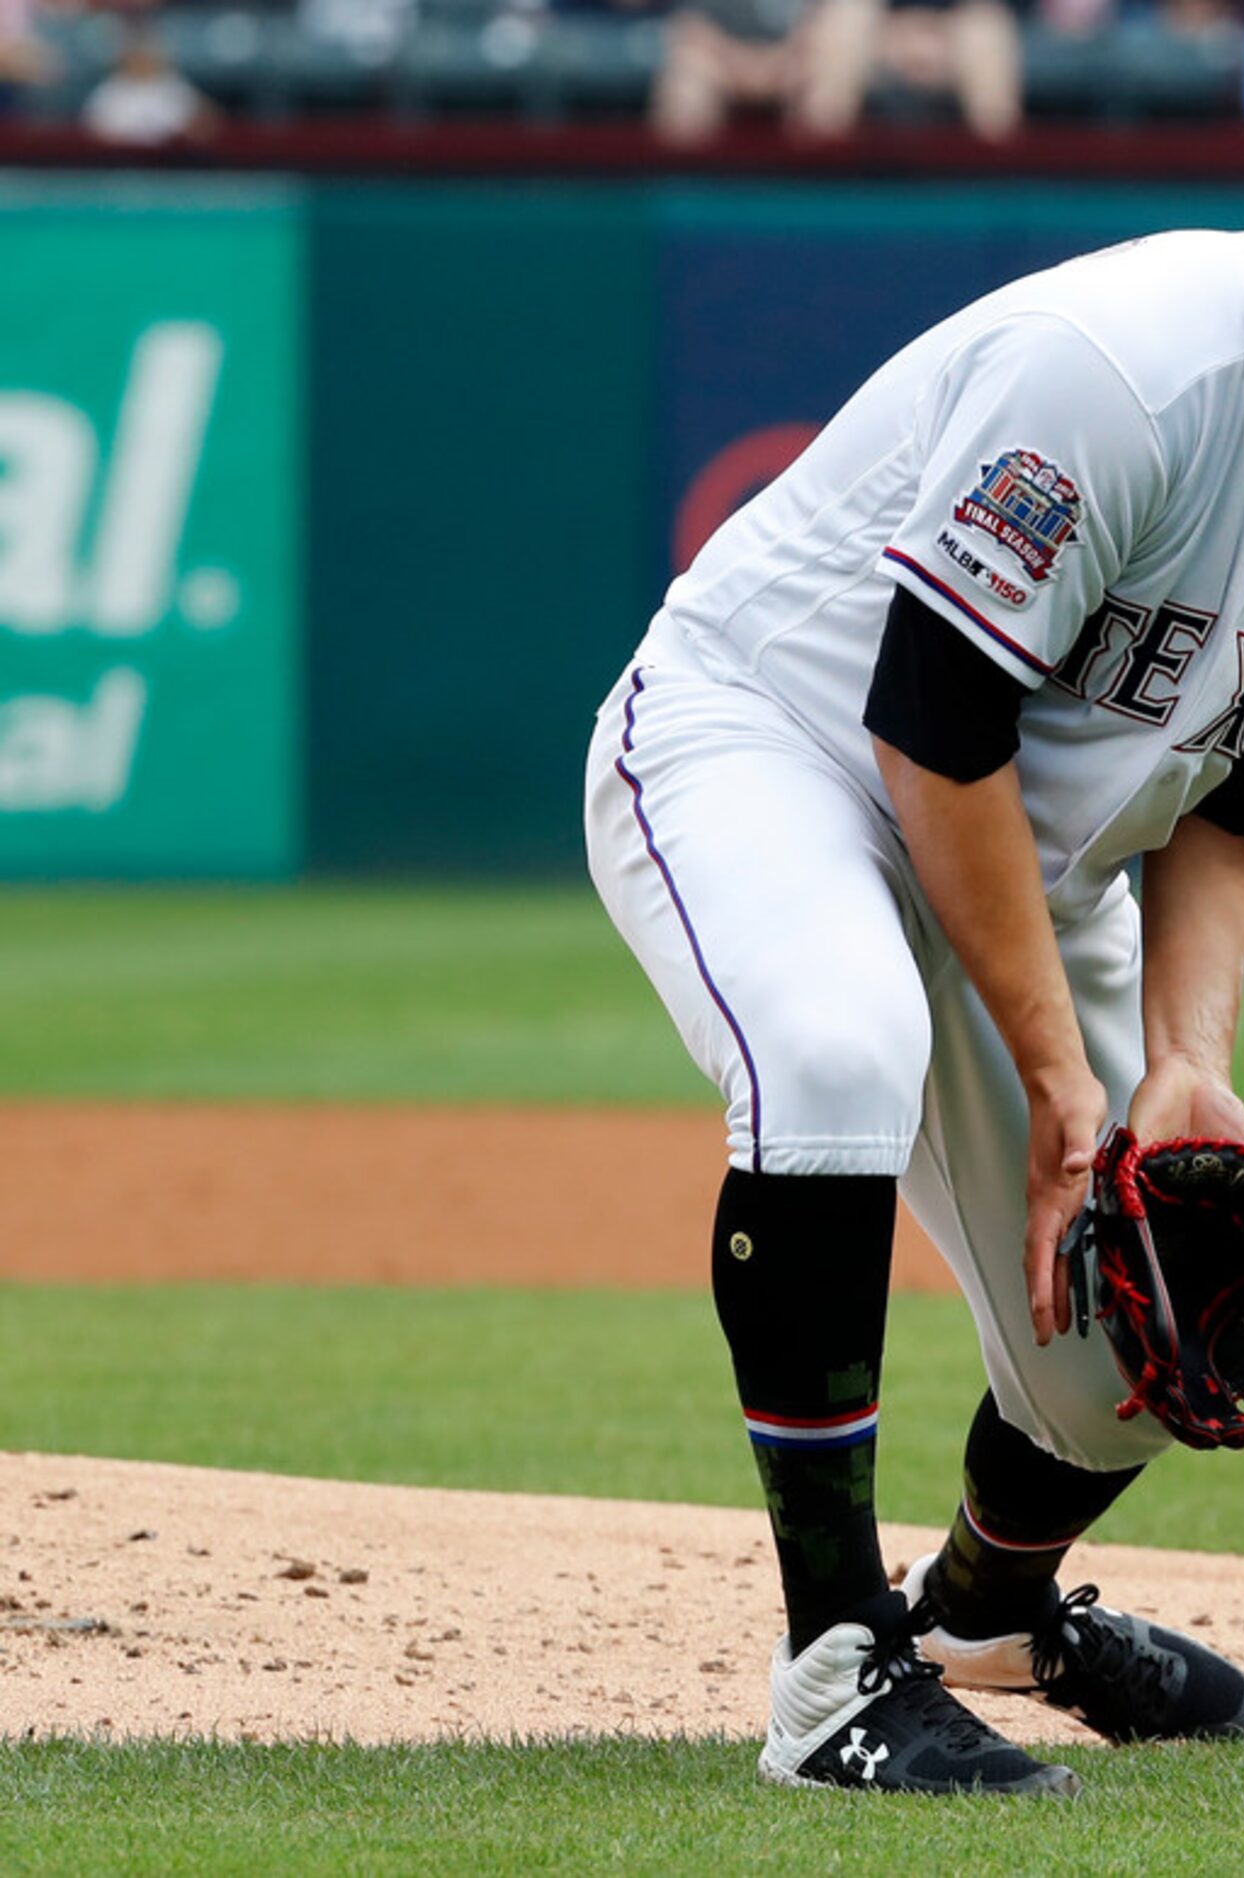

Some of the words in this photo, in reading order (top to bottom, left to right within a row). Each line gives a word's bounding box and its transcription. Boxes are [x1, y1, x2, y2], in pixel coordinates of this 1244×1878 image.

[937, 530, 974, 571] MLB
[965, 503, 1000, 533] FINAL
[1000, 526, 1046, 568] SEASON
